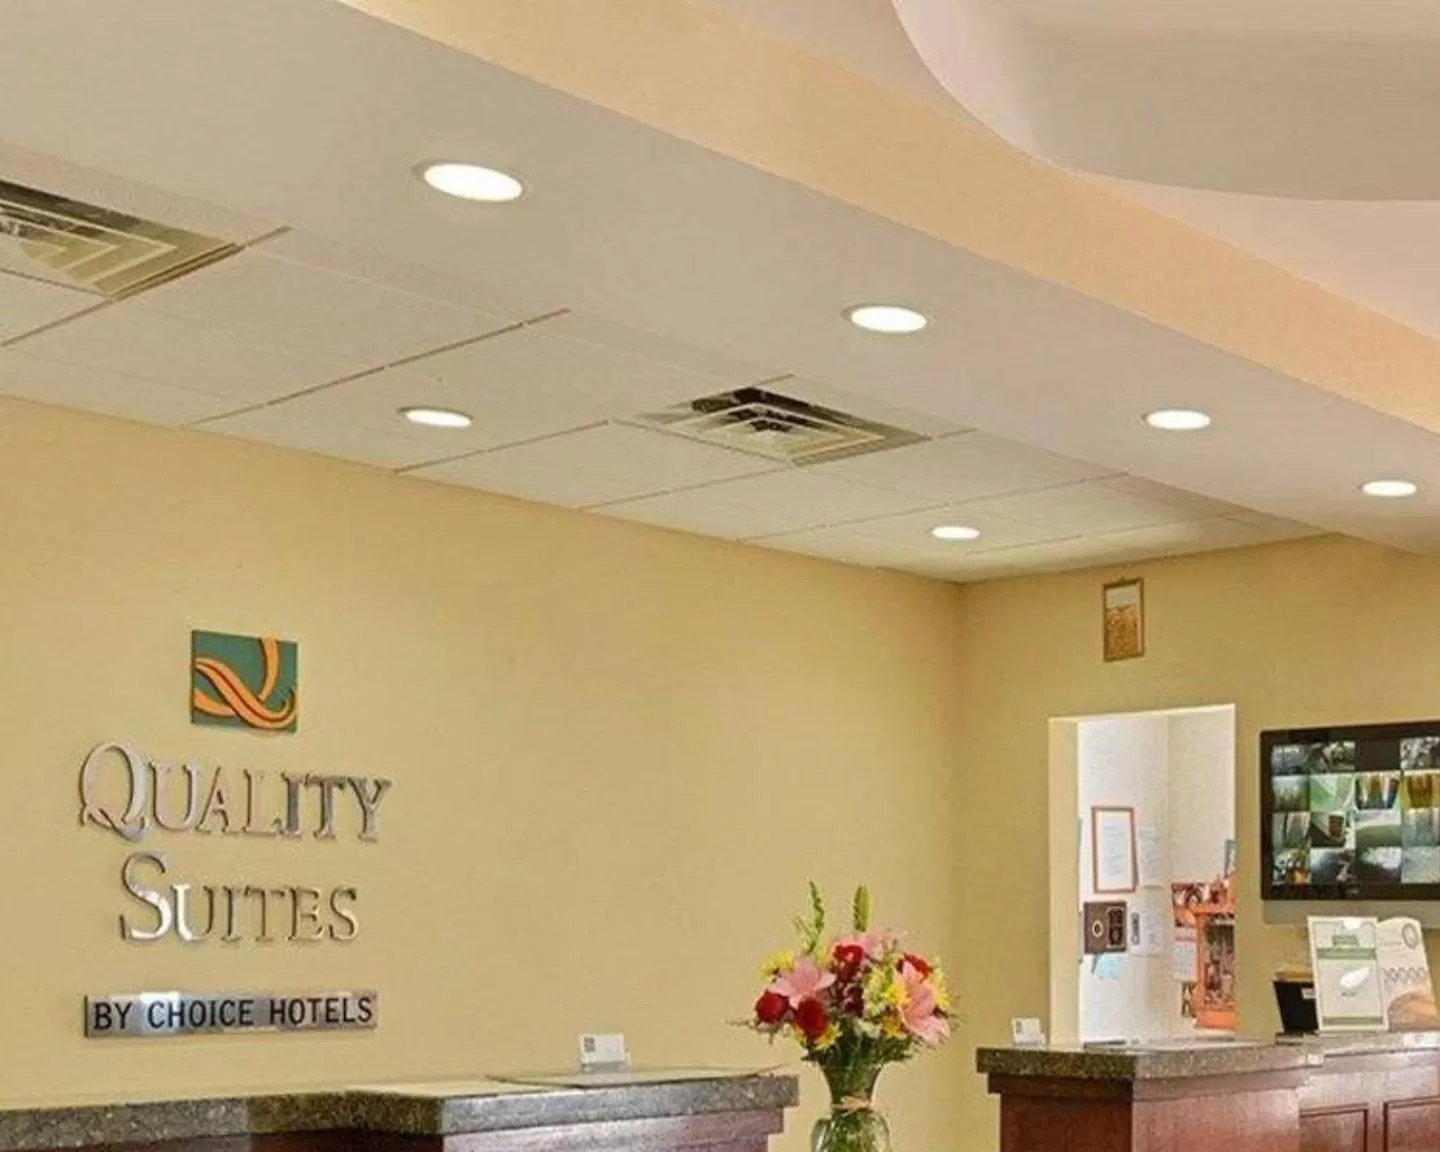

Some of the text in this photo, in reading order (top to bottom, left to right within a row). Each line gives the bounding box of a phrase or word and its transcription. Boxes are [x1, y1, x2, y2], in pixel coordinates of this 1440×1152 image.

[78, 739, 393, 844] QUALITY
[118, 849, 362, 944] SUITES
[93, 996, 373, 1030] BY CHOICE HOTELS
